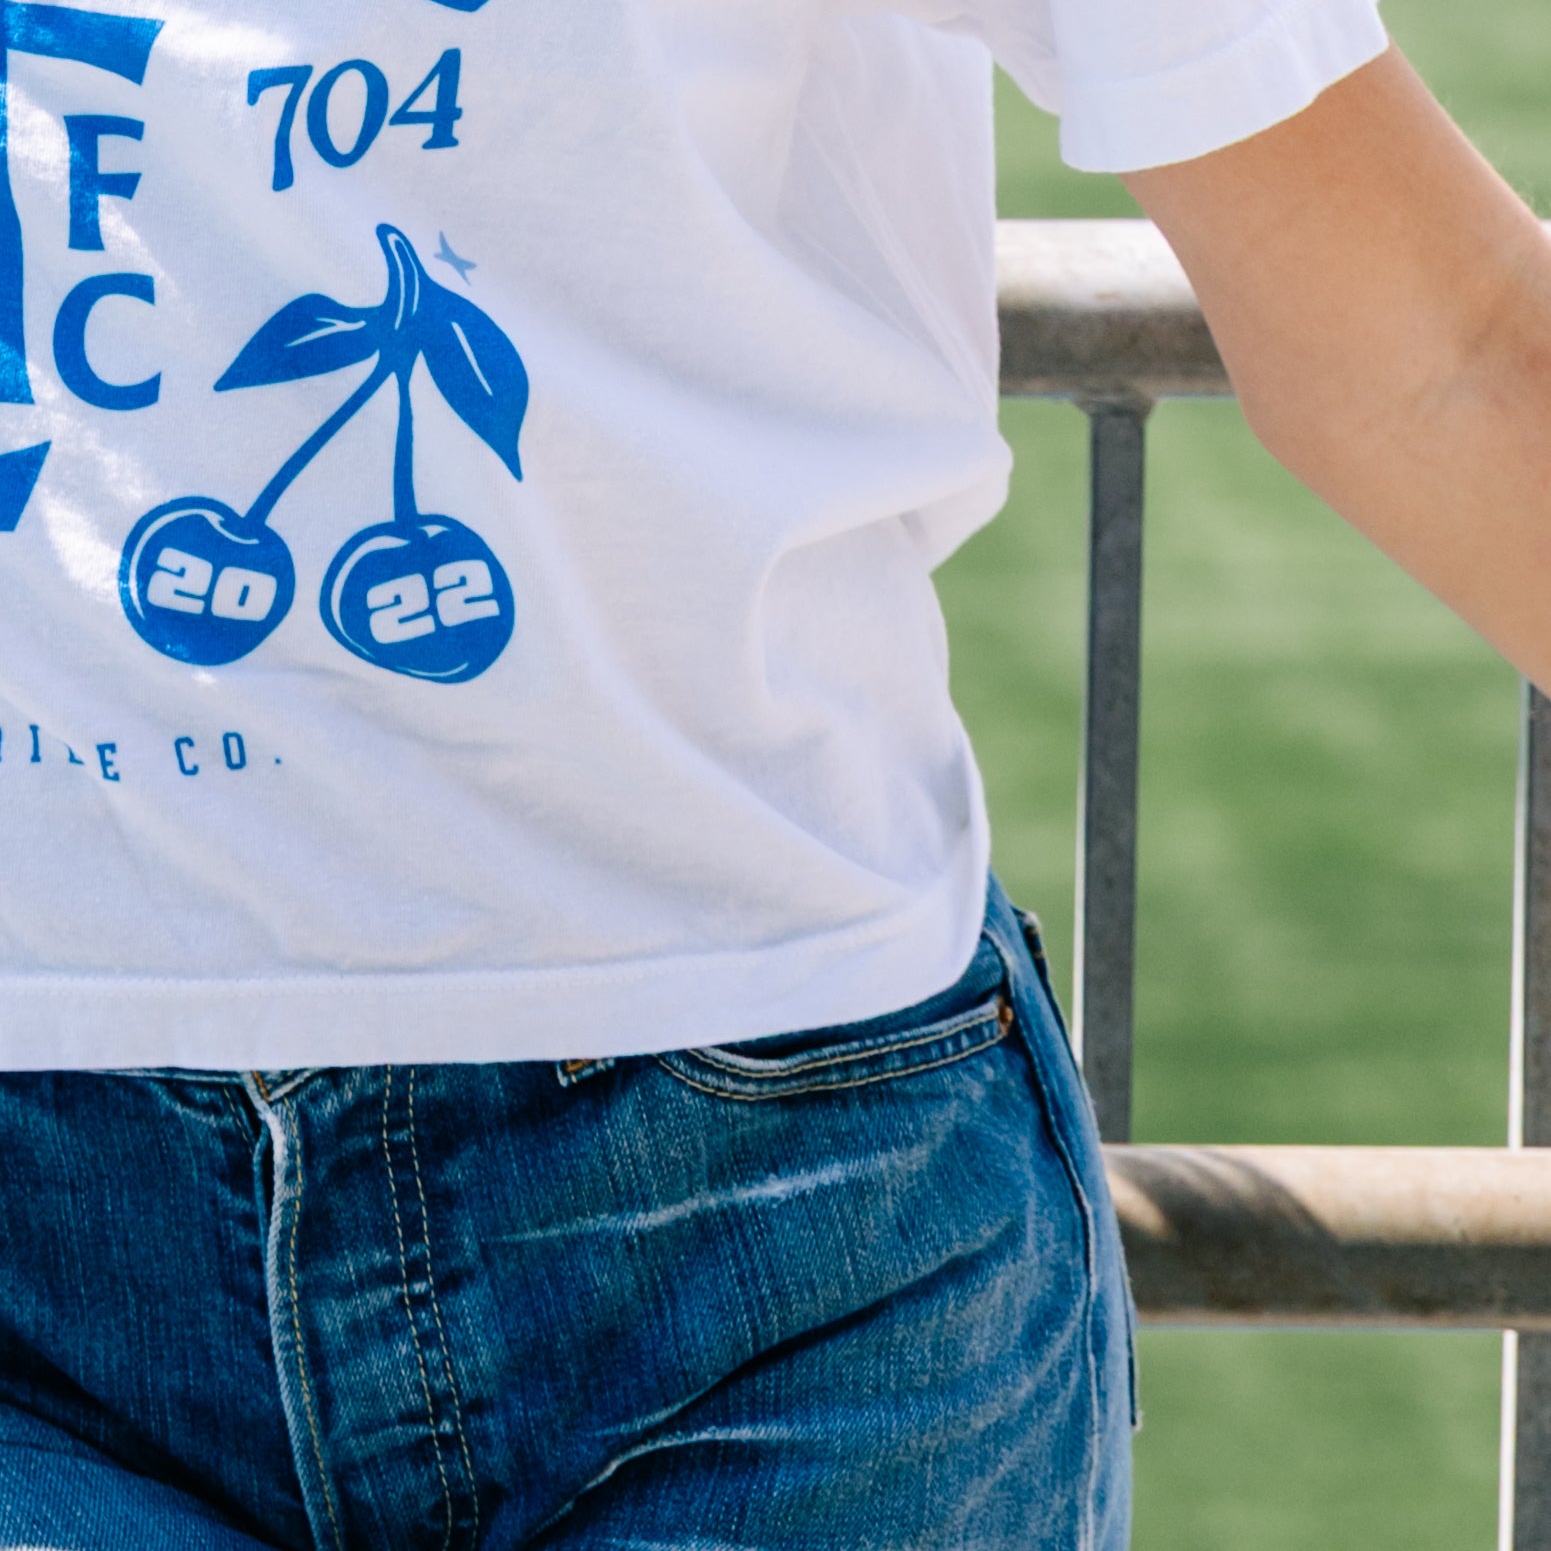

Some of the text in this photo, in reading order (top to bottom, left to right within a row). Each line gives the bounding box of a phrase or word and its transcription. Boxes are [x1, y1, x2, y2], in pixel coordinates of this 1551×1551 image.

[246, 47, 463, 192] 704
[147, 546, 501, 645] 20 22
[173, 731, 283, 777] CO.
